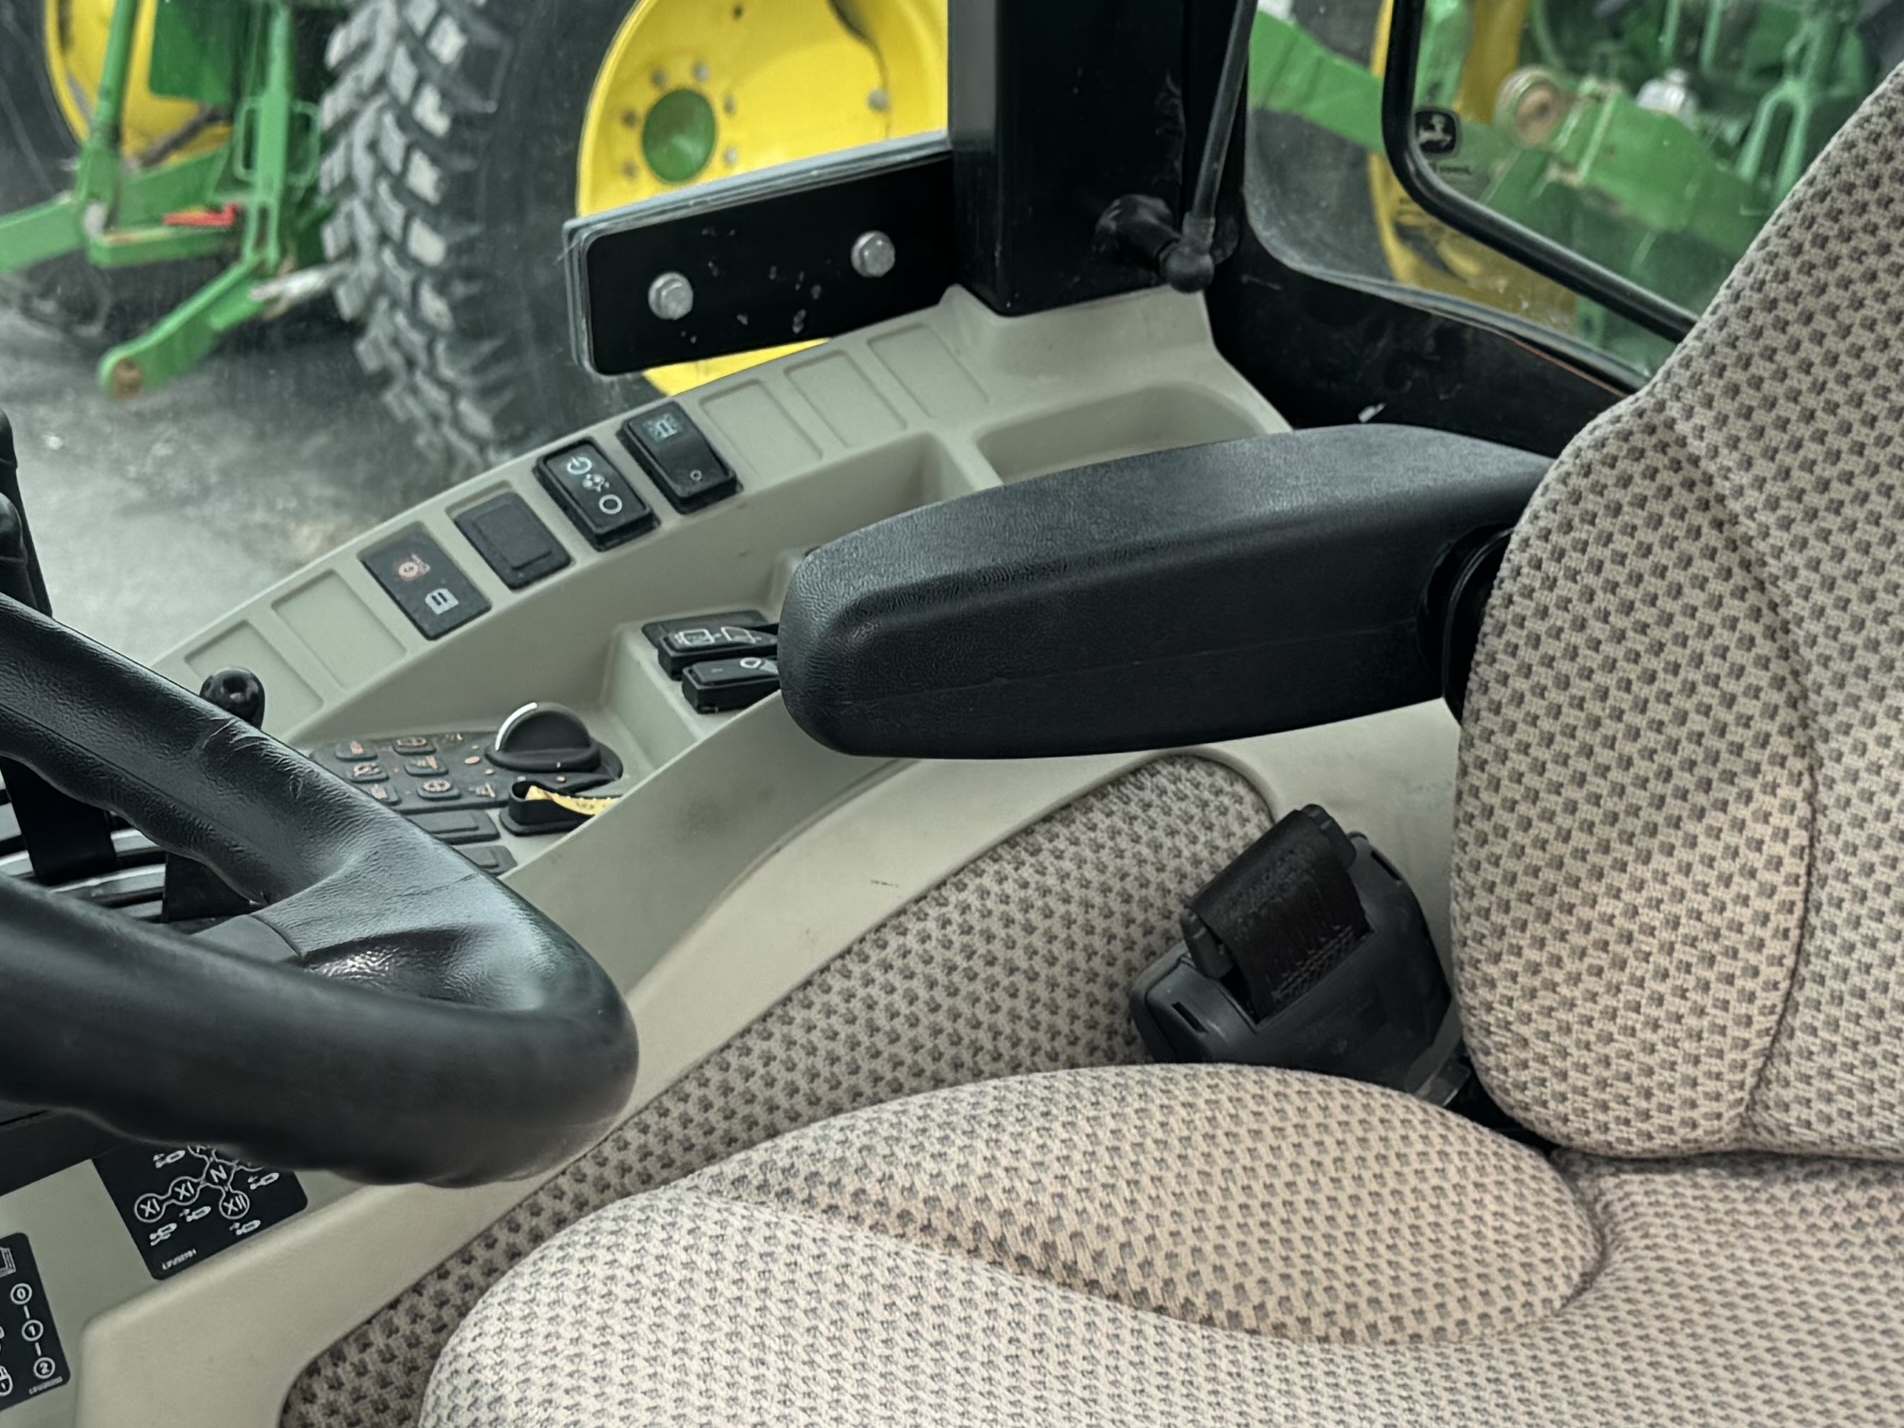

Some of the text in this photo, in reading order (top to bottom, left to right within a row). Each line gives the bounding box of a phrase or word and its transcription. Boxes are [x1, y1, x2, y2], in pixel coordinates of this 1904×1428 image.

[209, 1165, 228, 1183] N
[16, 1288, 26, 1300] 0
[28, 1325, 36, 1336] 1
[39, 1362, 50, 1375] 2
